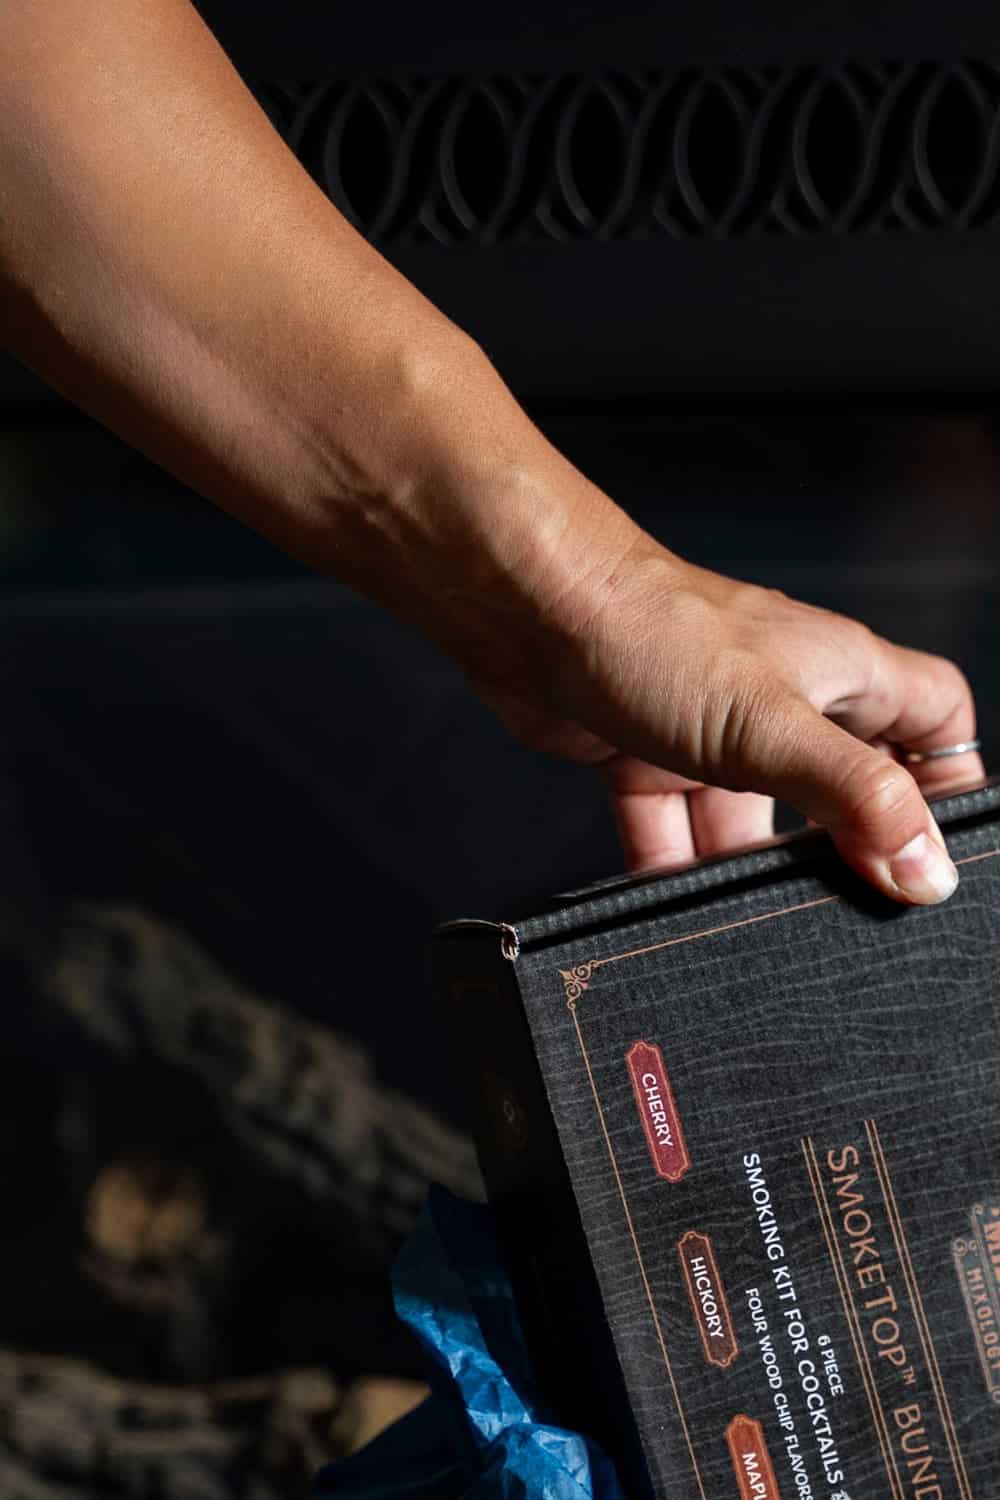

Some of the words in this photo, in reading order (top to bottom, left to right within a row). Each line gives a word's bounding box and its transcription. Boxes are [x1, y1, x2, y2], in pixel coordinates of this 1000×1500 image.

[642, 1073, 673, 1147] CHERRY
[743, 1152, 785, 1261] SMOKING
[690, 1256, 725, 1339] HICKORY
[773, 1265, 798, 1301] KIT
[745, 1287, 769, 1334] FOUR
[758, 1334, 784, 1390] WOOD
[773, 1392, 796, 1432] CHIP
[783, 1308, 810, 1355] FOR
[817, 1335, 831, 1347] 6
[821, 1348, 845, 1396] PIECE
[798, 1359, 845, 1485] COCKTAILS
